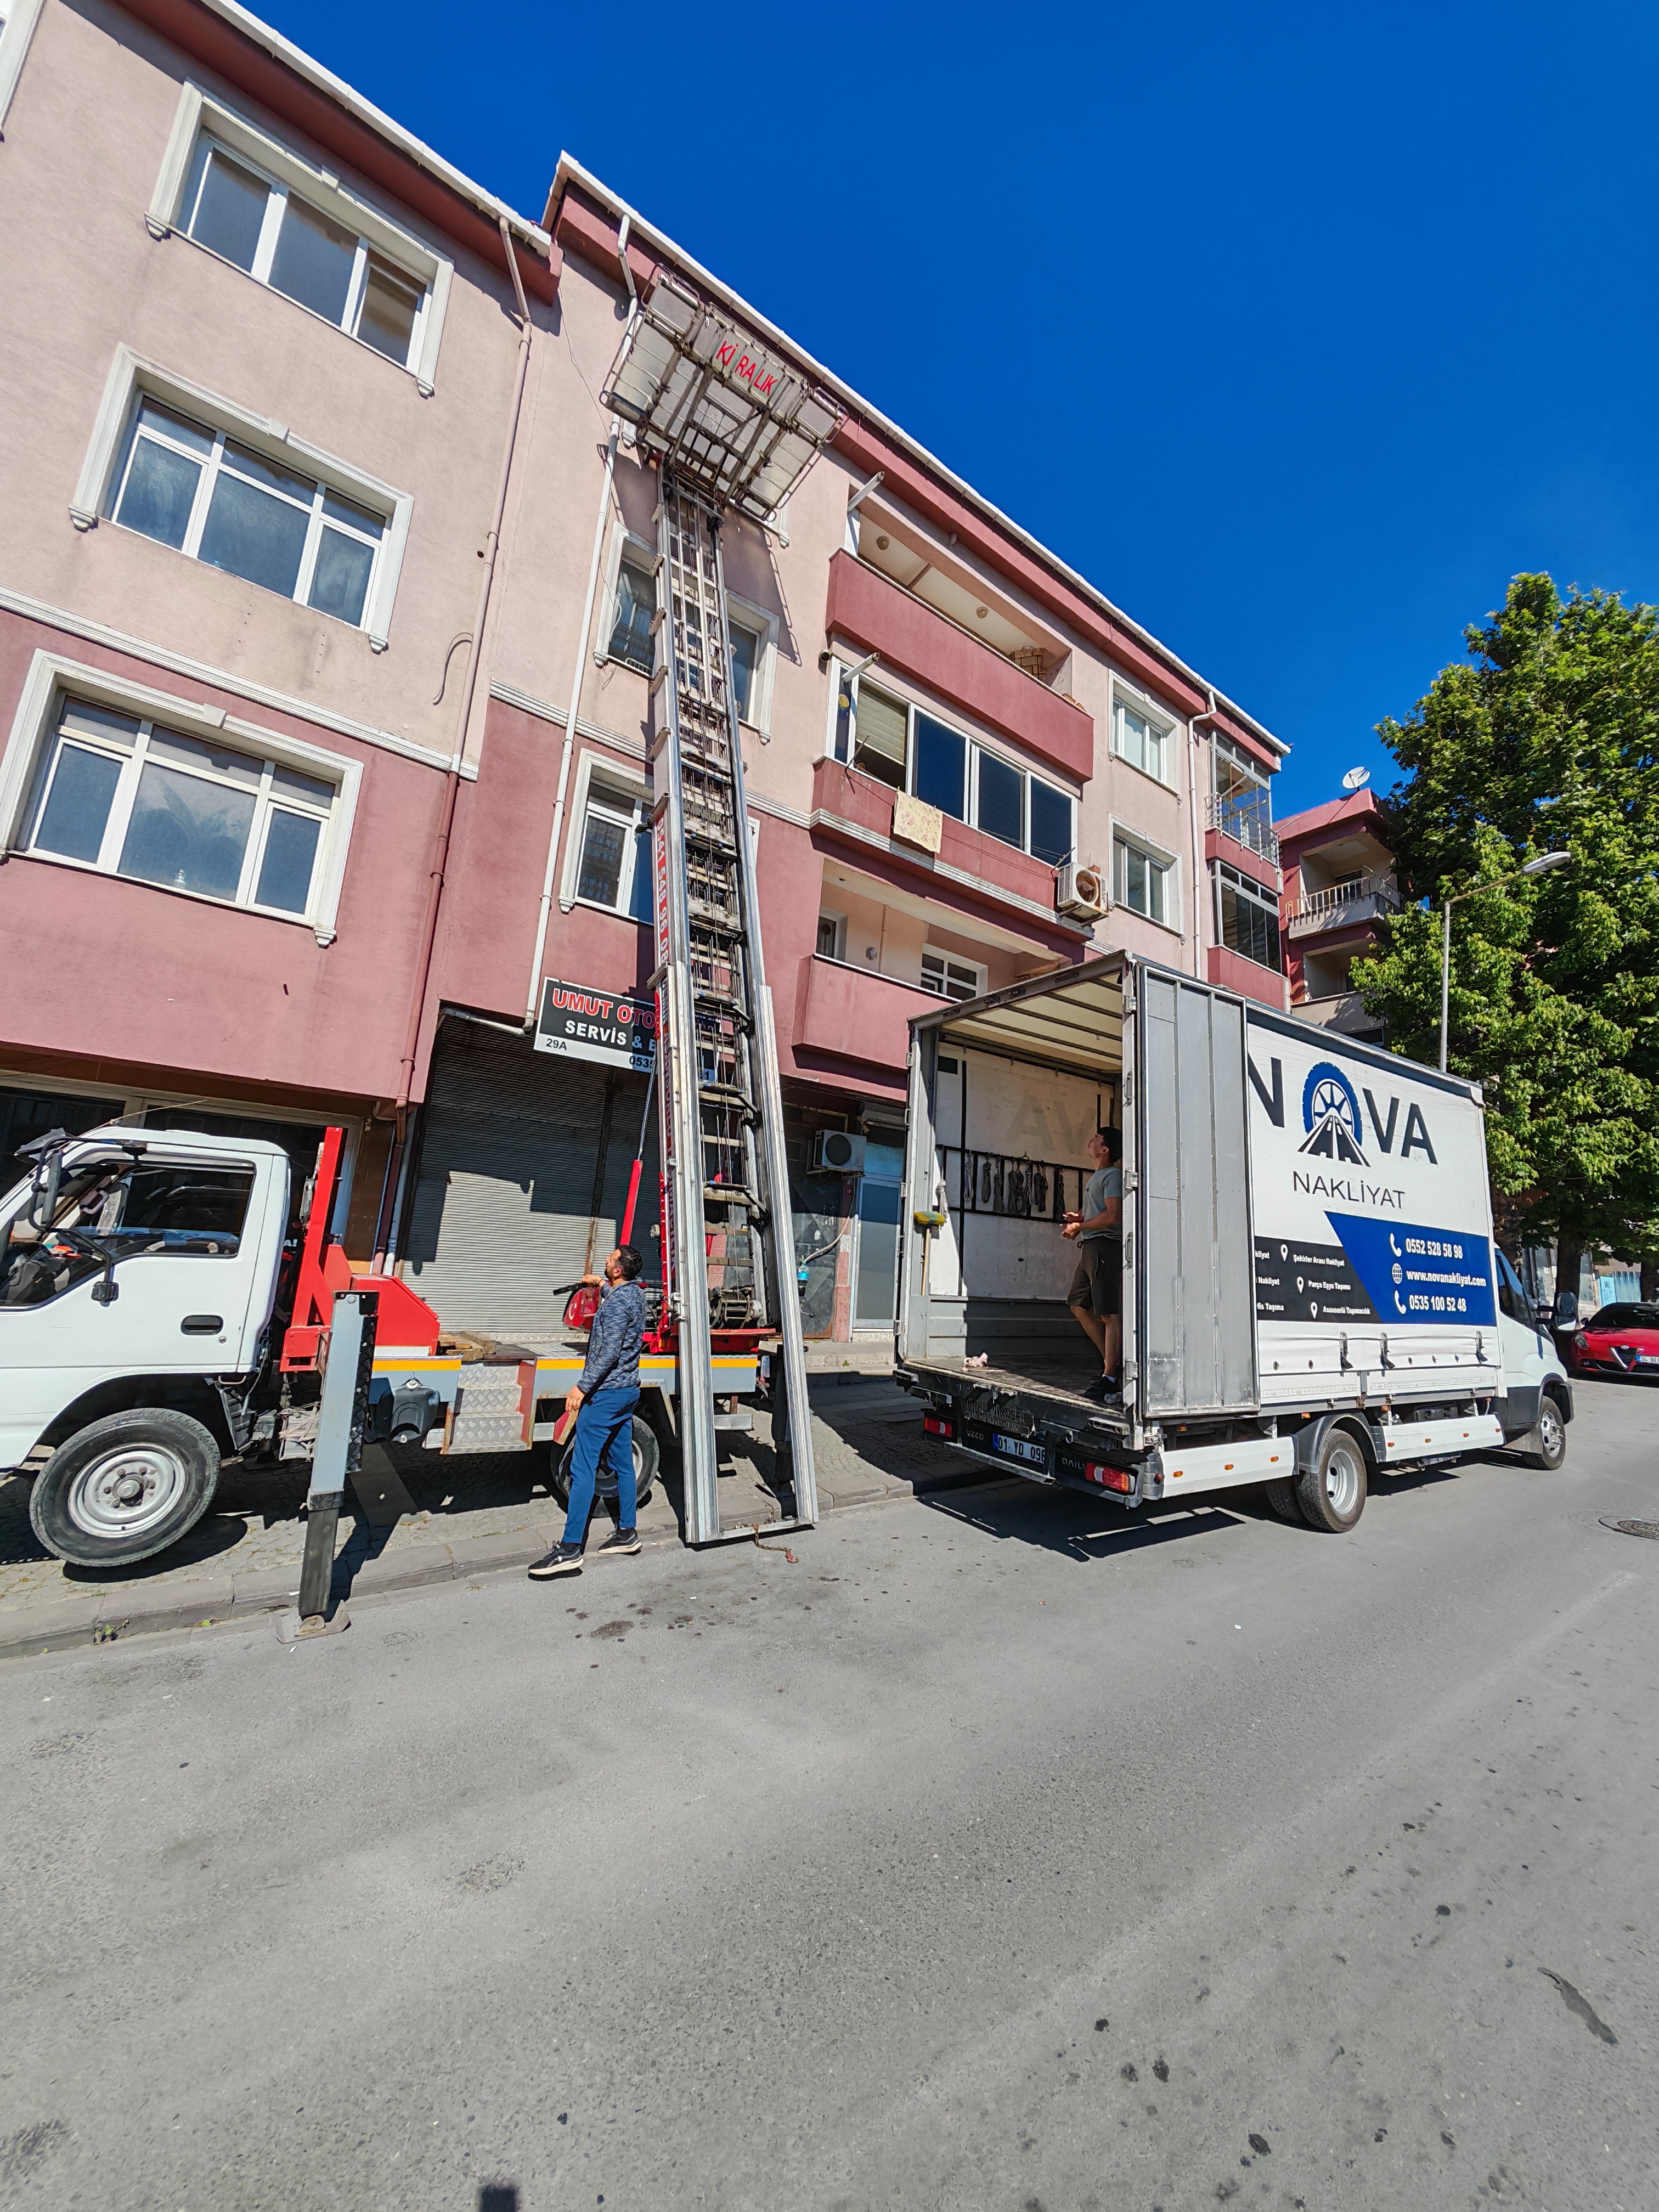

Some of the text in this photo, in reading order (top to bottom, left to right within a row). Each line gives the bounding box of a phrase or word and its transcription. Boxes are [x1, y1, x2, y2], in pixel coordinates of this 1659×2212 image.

[658, 866, 668, 905] 548
[659, 906, 668, 934] 96
[552, 988, 656, 1029] UMUT OTO
[565, 1020, 628, 1046] SERVİS
[631, 1036, 643, 1049] &
[545, 1038, 567, 1051] 29A
[1293, 1171, 1406, 1209] NAKLİYAT
[1255, 1250, 1270, 1260] kliyat
[1406, 1238, 1463, 1259] 0552 528 58 98
[1293, 1254, 1345, 1267] Şehirler Arası Nakliyat
[1258, 1276, 1280, 1286] Nakliyat
[1308, 1280, 1323, 1290] Parça
[1406, 1271, 1486, 1287] www.novanakliyat.com
[1257, 1302, 1284, 1312] fis Taşıma
[1409, 1295, 1467, 1312] 0535 100 52 48
[998, 1437, 1008, 1451] 01
[1013, 1441, 1024, 1456] YD
